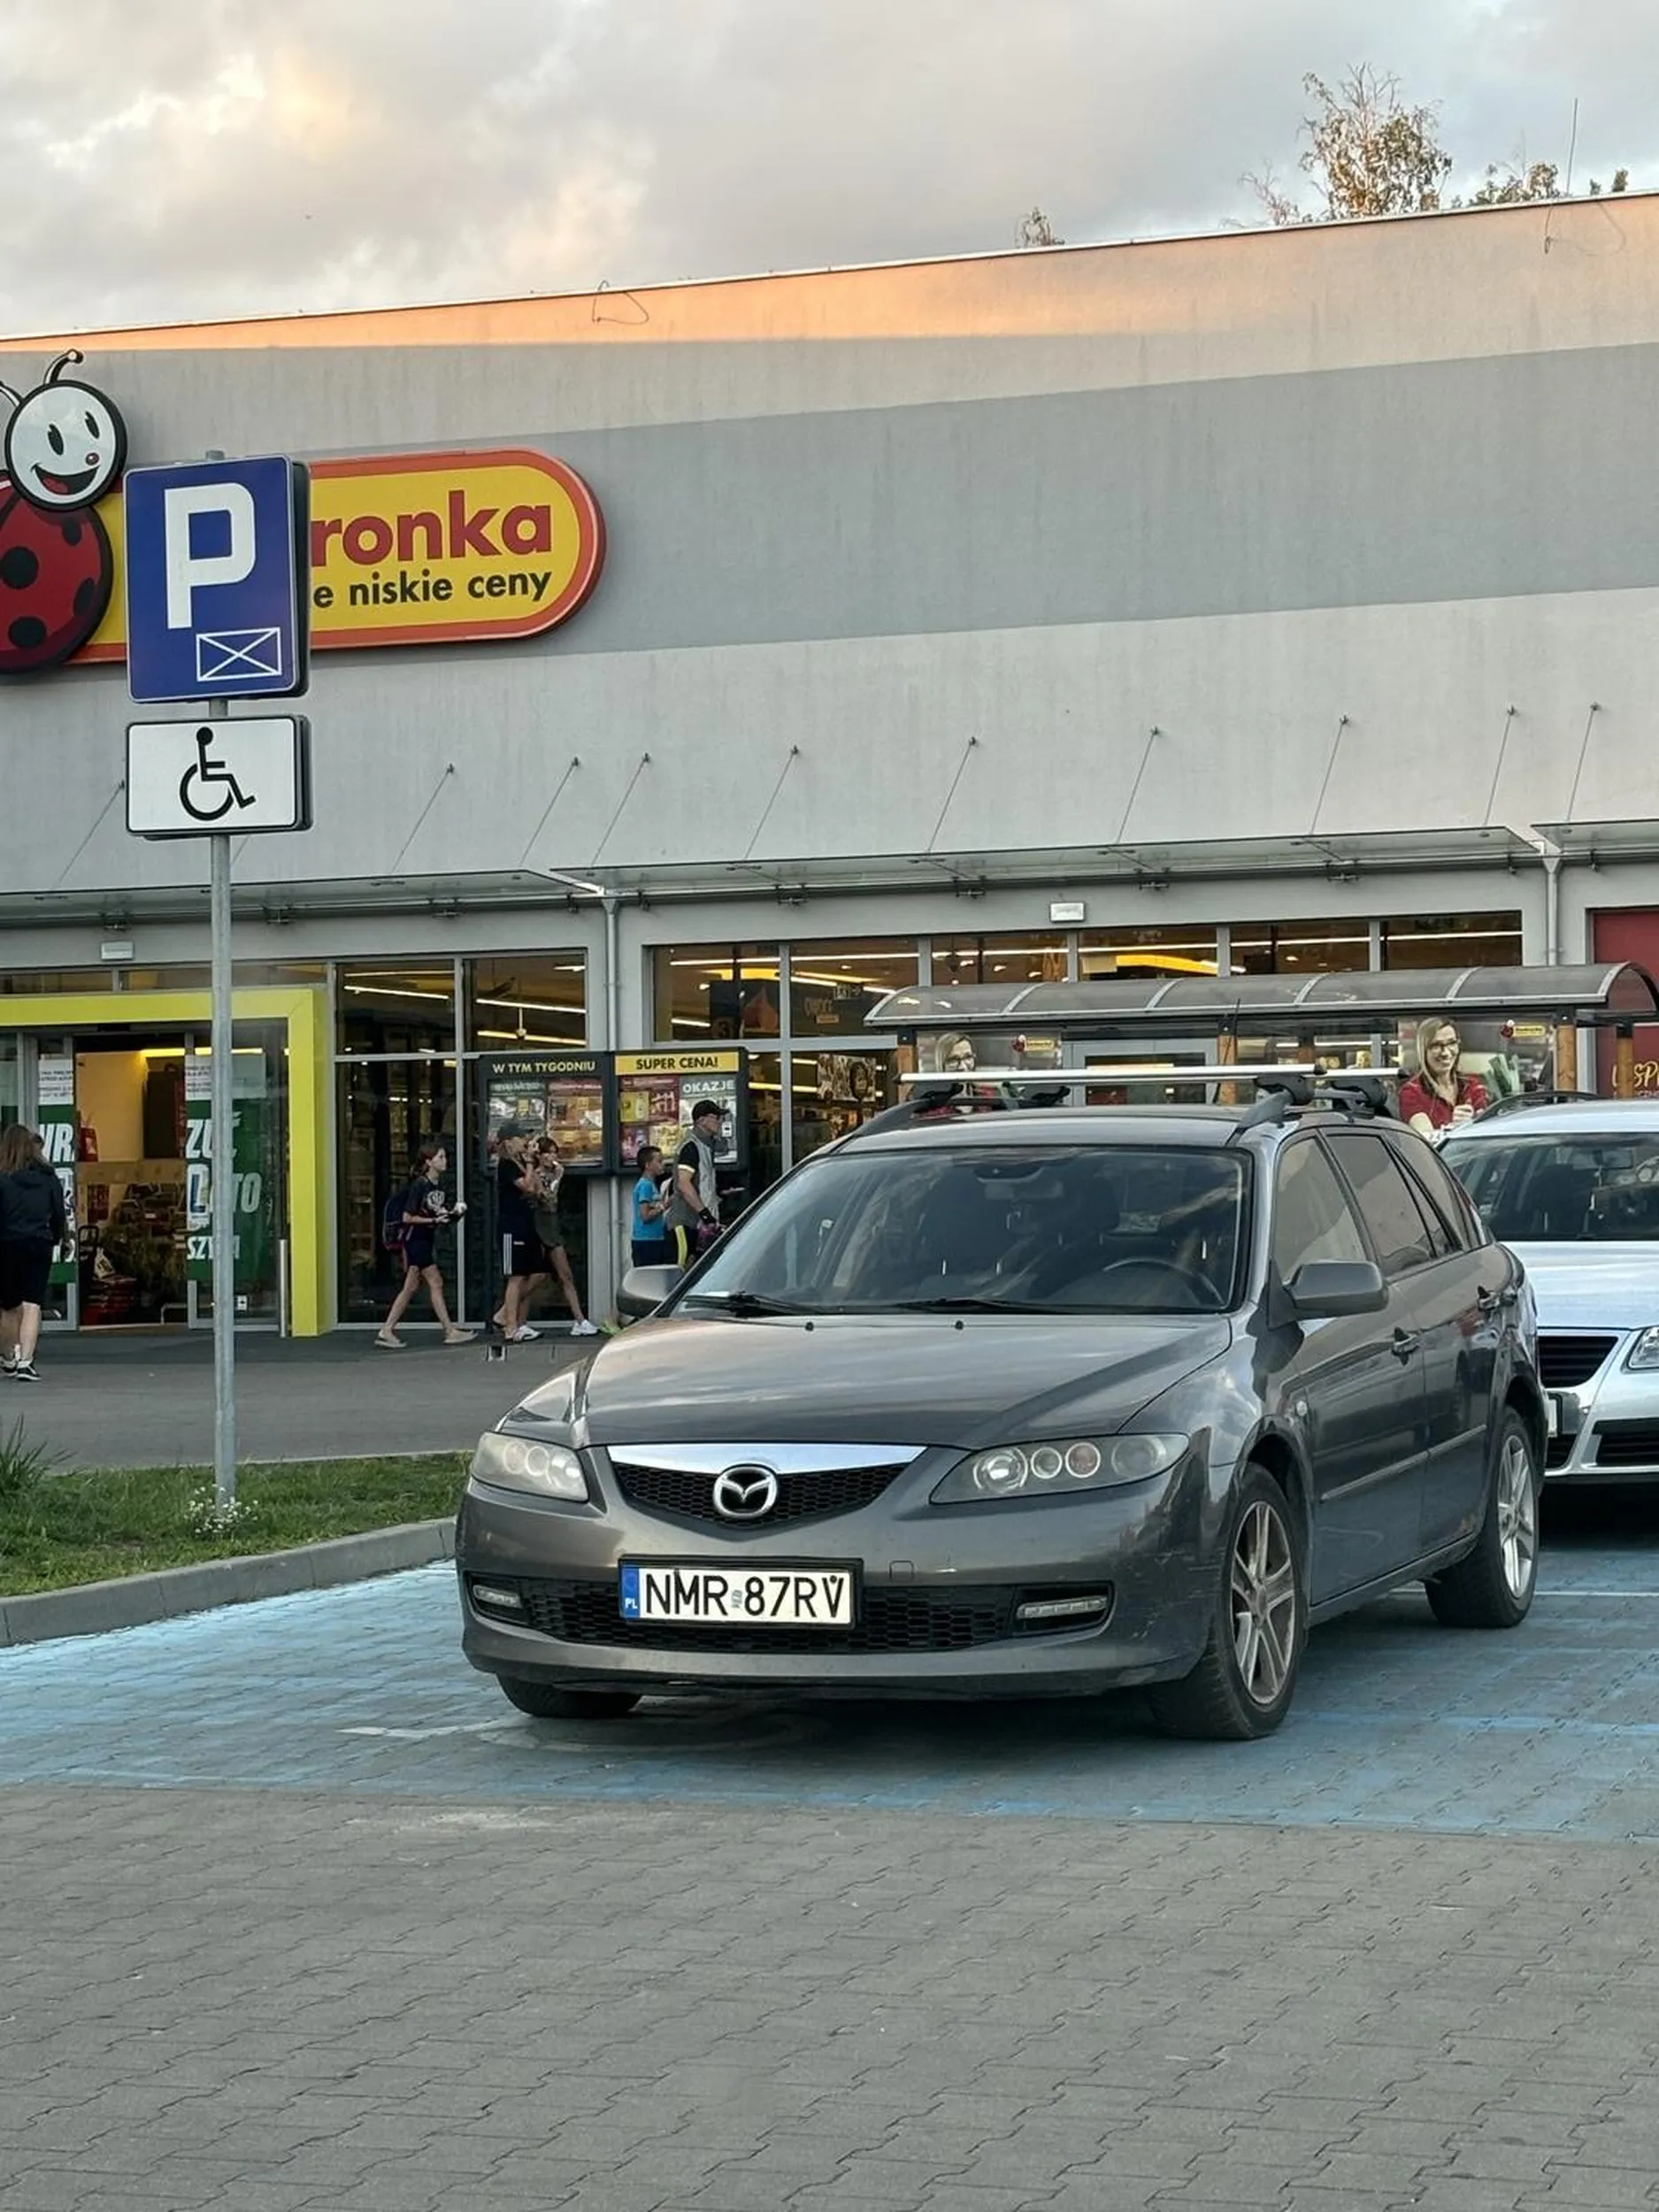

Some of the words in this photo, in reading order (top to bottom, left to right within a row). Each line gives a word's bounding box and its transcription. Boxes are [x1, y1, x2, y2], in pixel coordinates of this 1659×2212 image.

[311, 489, 553, 567] ronka
[164, 483, 257, 629] P
[349, 569, 454, 606] niskie
[467, 571, 553, 602] ceny
[492, 1063, 507, 1073] W
[507, 1063, 533, 1073] TYM
[534, 1061, 596, 1072] TYGODNIU
[635, 1057, 676, 1070] SUPER
[679, 1056, 719, 1069] CENA!
[681, 1079, 735, 1094] OKAZJE
[645, 1572, 729, 1617] NMR
[744, 1575, 845, 1618] 87RV
